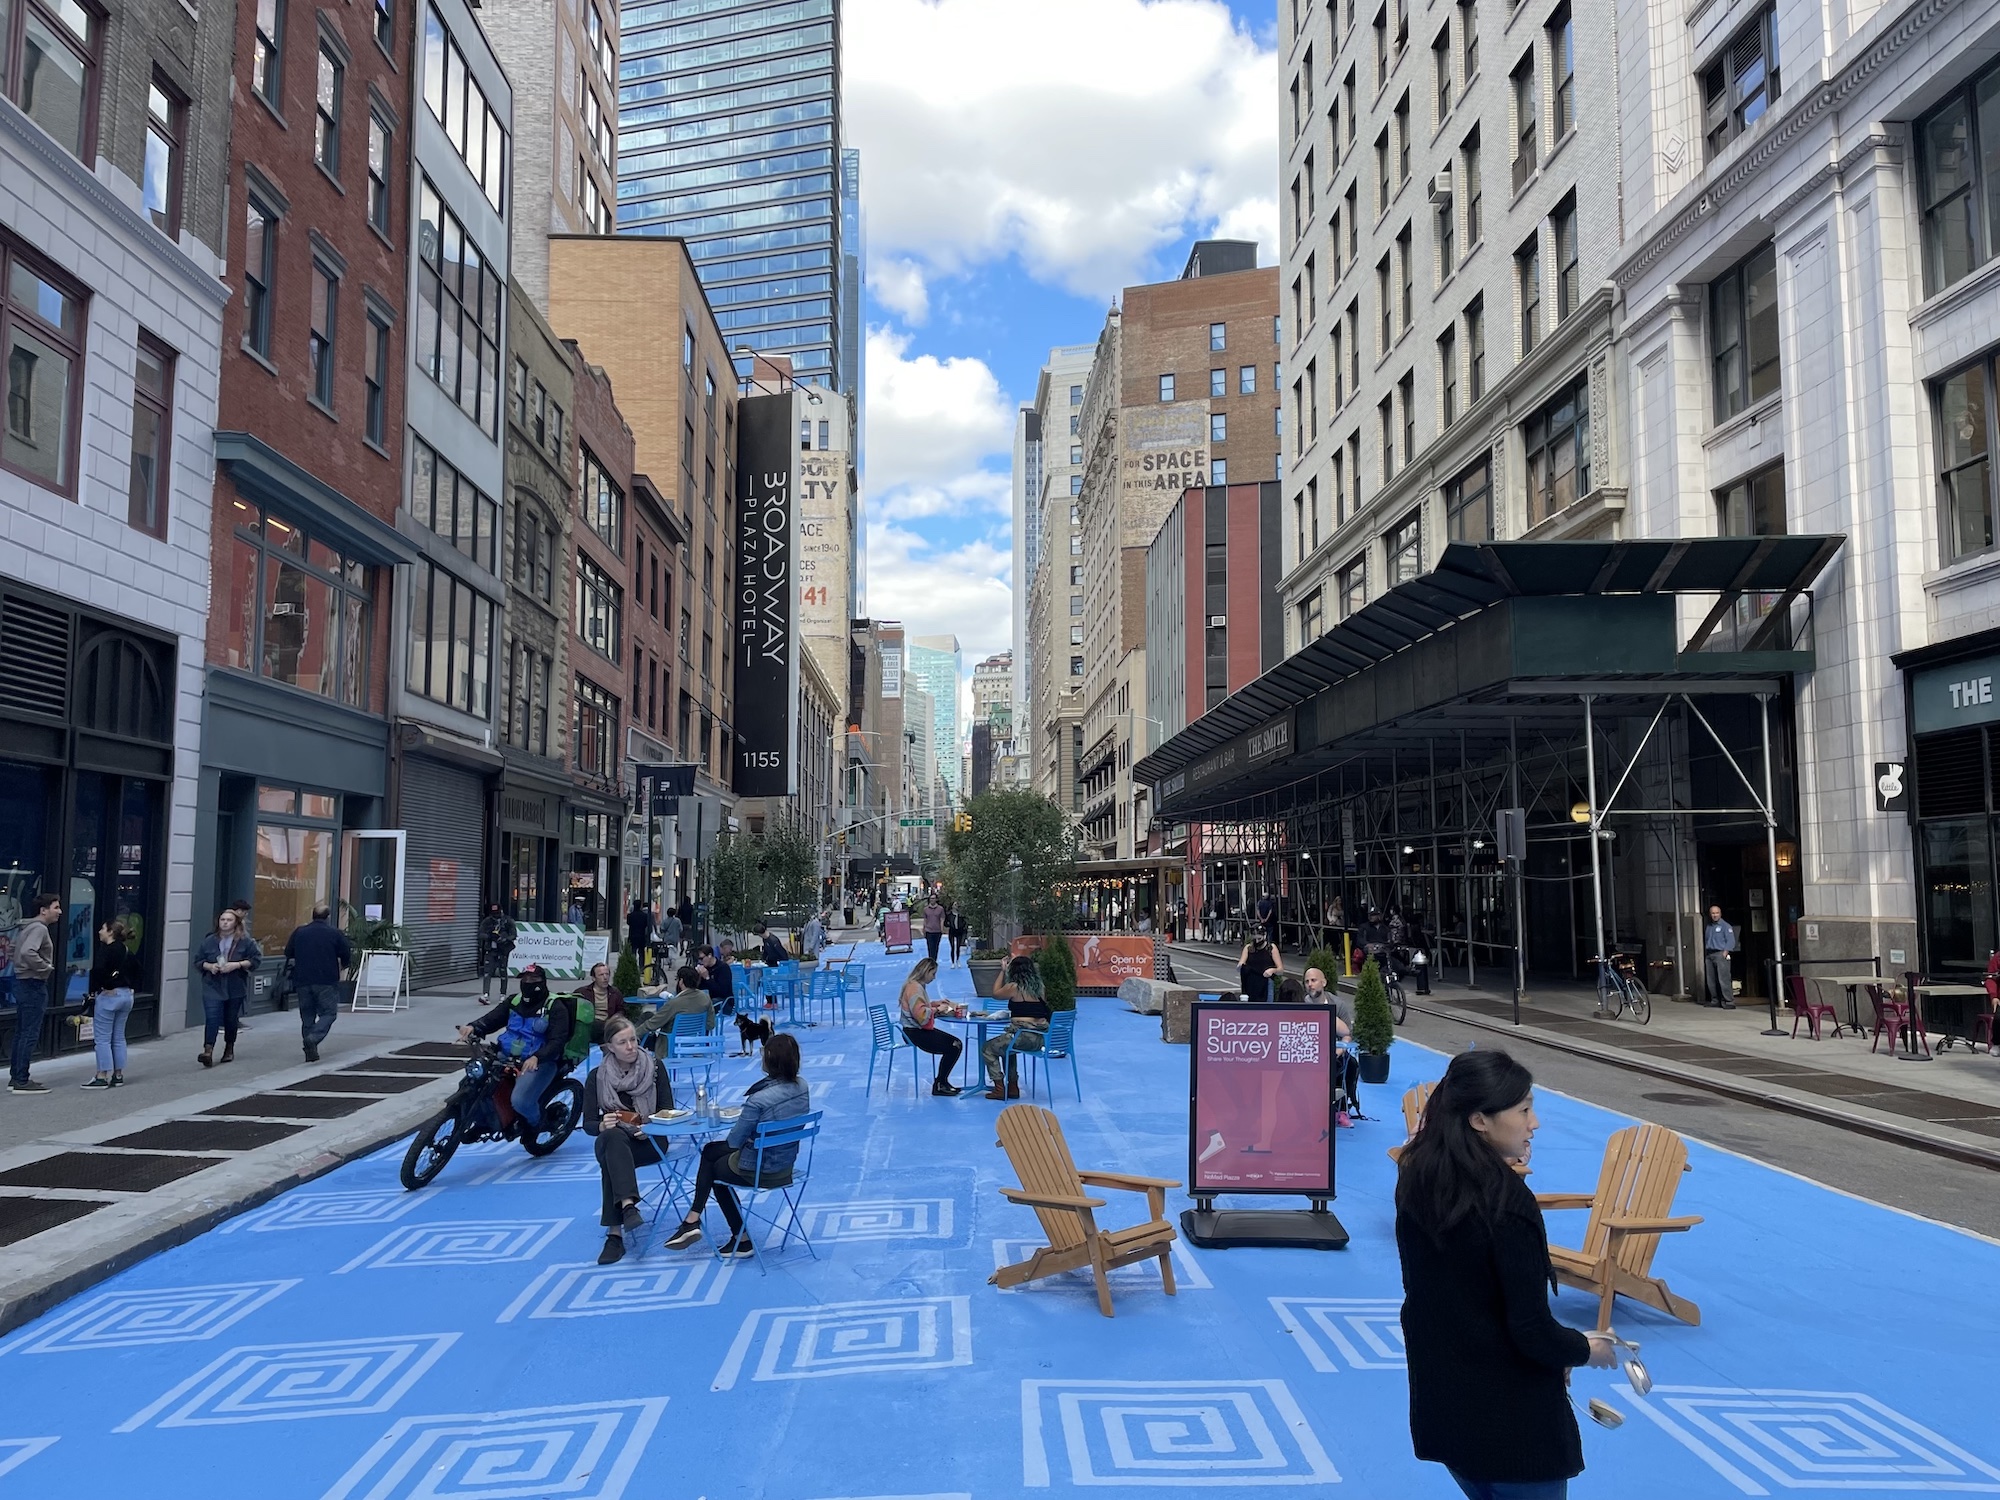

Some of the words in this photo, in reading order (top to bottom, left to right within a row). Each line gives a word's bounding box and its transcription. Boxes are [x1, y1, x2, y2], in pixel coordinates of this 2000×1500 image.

[1124, 460, 1140, 469] FOR
[1143, 450, 1205, 471] SPACE
[1123, 481, 1132, 489] IN
[1134, 479, 1152, 488] THIS
[1154, 471, 1207, 490] AREA
[743, 498, 757, 565] PLAZA
[762, 471, 786, 666] BROADWAY
[742, 574, 757, 645] HOTEL
[1948, 676, 1993, 709] THE
[1247, 735, 1263, 758] THE
[1263, 721, 1288, 751] SMITH
[742, 751, 780, 768] 1155
[1192, 755, 1220, 781] RESTAURANT
[1224, 748, 1235, 767] BAR
[1881, 782, 1899, 792] little
[516, 936, 542, 945] ellow
[543, 936, 574, 947] Barber
[511, 952, 540, 960] Walk-ins
[541, 953, 573, 961] Welcome
[1110, 955, 1135, 965] Open
[1135, 954, 1148, 964] for
[1110, 964, 1142, 976] Cycling
[1208, 1018, 1269, 1036] Piazza
[1207, 1036, 1273, 1059] Survey
